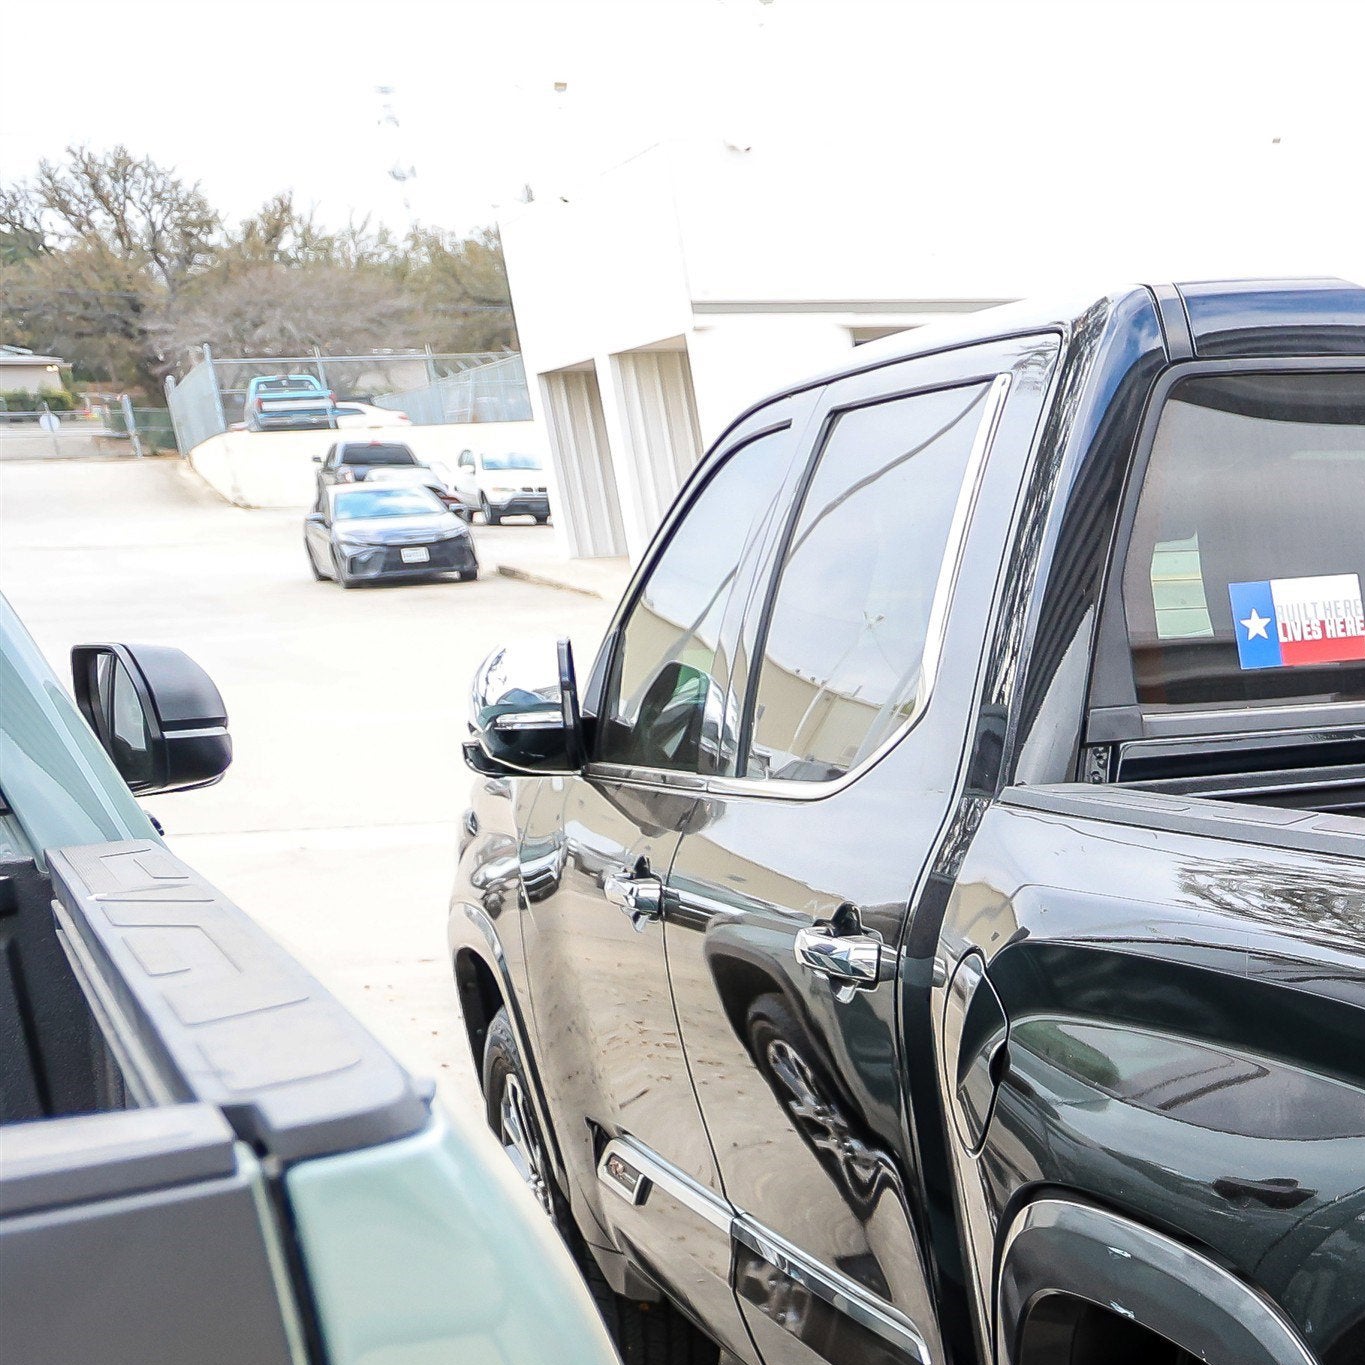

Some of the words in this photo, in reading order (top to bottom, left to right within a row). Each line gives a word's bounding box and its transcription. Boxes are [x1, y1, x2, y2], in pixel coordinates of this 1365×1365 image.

[1276, 602, 1318, 622] BUILT
[1323, 599, 1362, 619] HERE
[1278, 619, 1322, 643] LIVES
